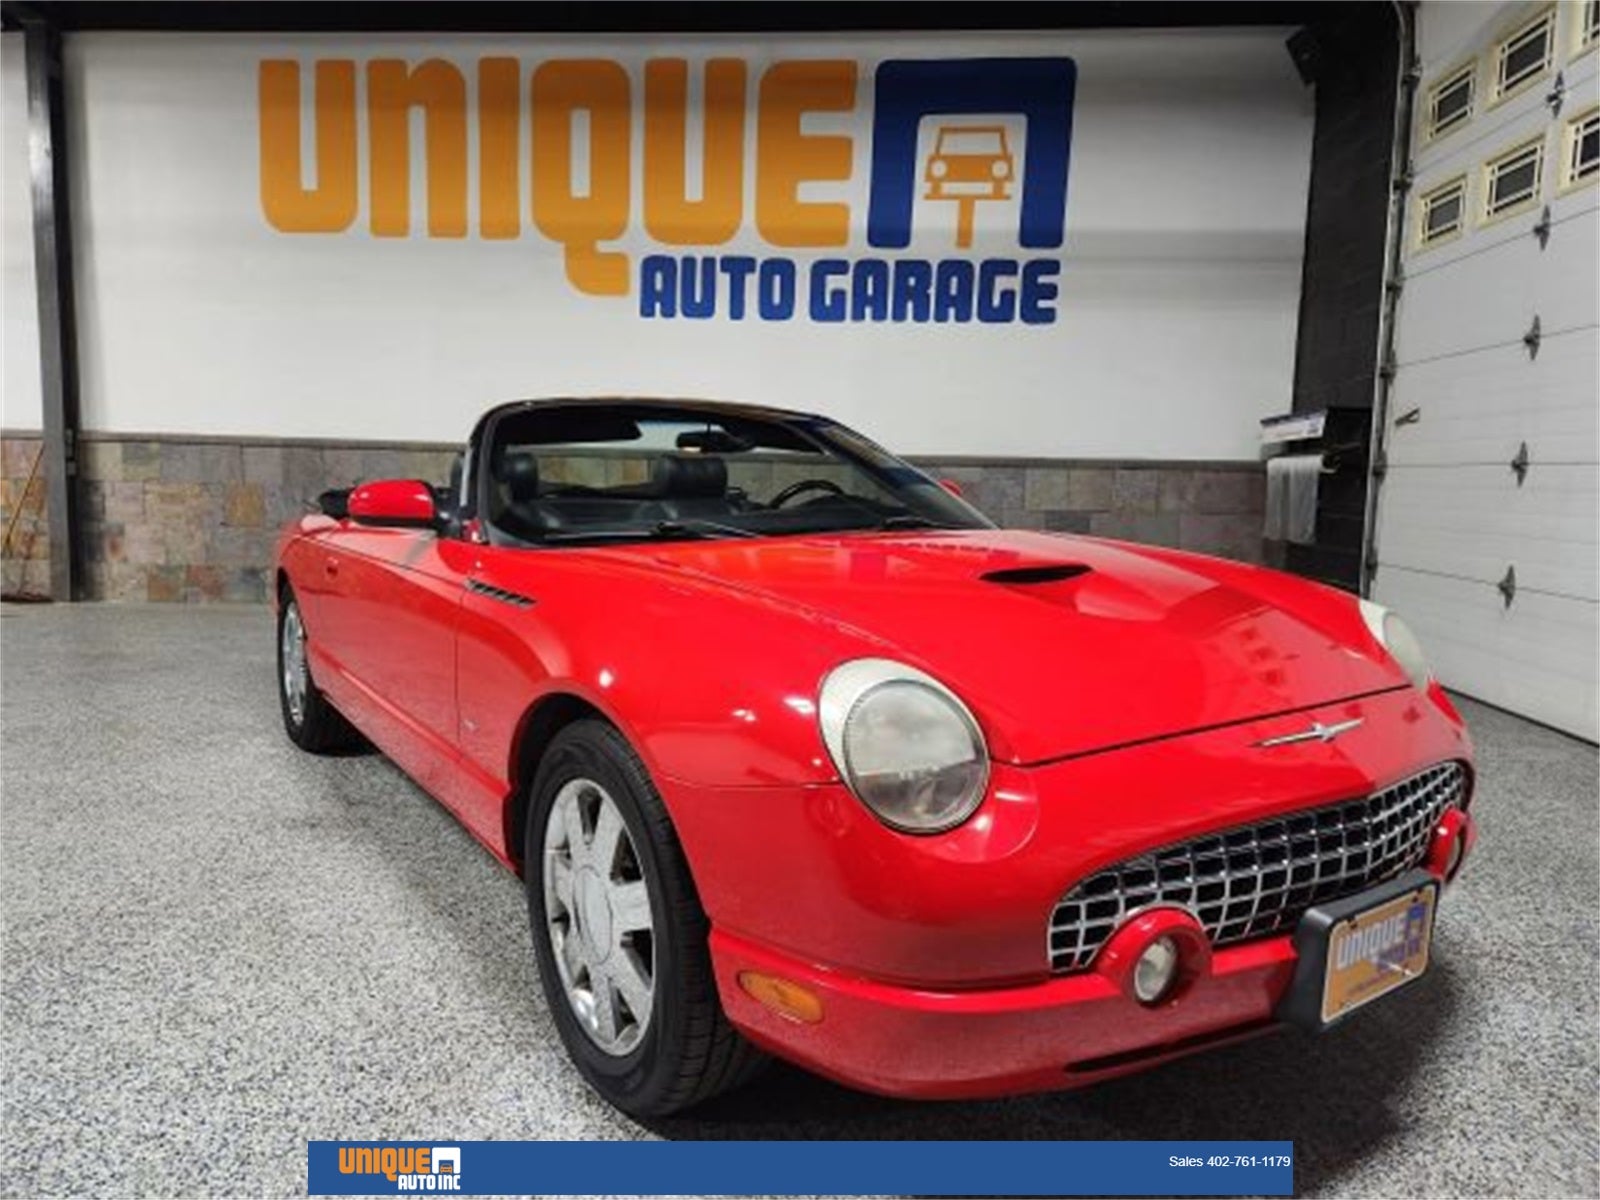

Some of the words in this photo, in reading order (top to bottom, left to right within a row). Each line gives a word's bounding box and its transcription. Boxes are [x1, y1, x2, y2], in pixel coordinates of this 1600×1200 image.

[258, 56, 858, 297] UNIQUE
[640, 254, 797, 321] AUTO
[808, 256, 1062, 325] GARAGE
